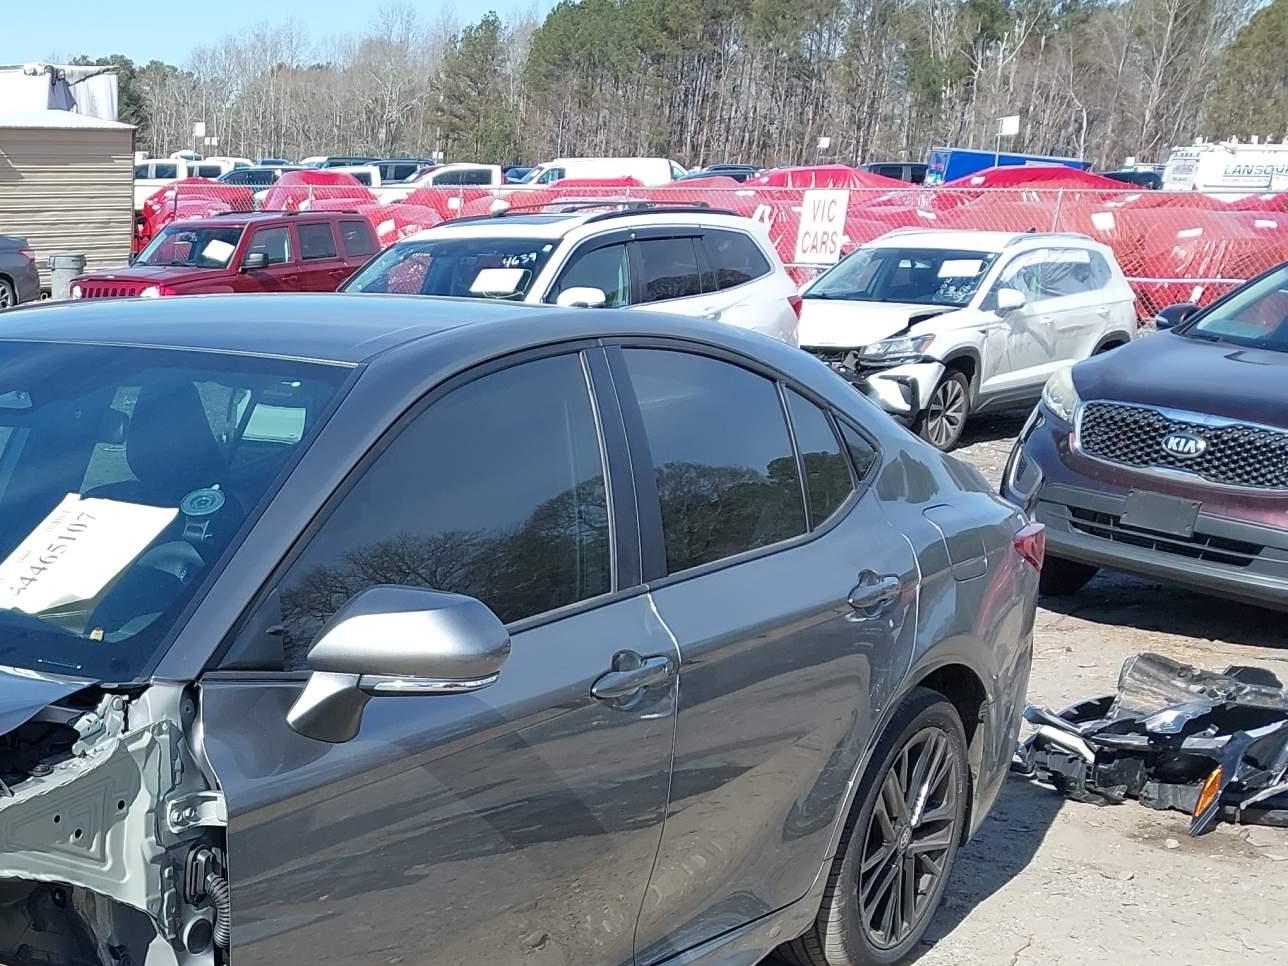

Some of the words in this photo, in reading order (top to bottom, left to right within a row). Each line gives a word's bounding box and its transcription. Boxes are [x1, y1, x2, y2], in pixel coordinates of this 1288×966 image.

[810, 199, 838, 223] VIC
[801, 230, 839, 255] CARS
[502, 252, 537, 268] 4639
[1159, 436, 1196, 453] KIA
